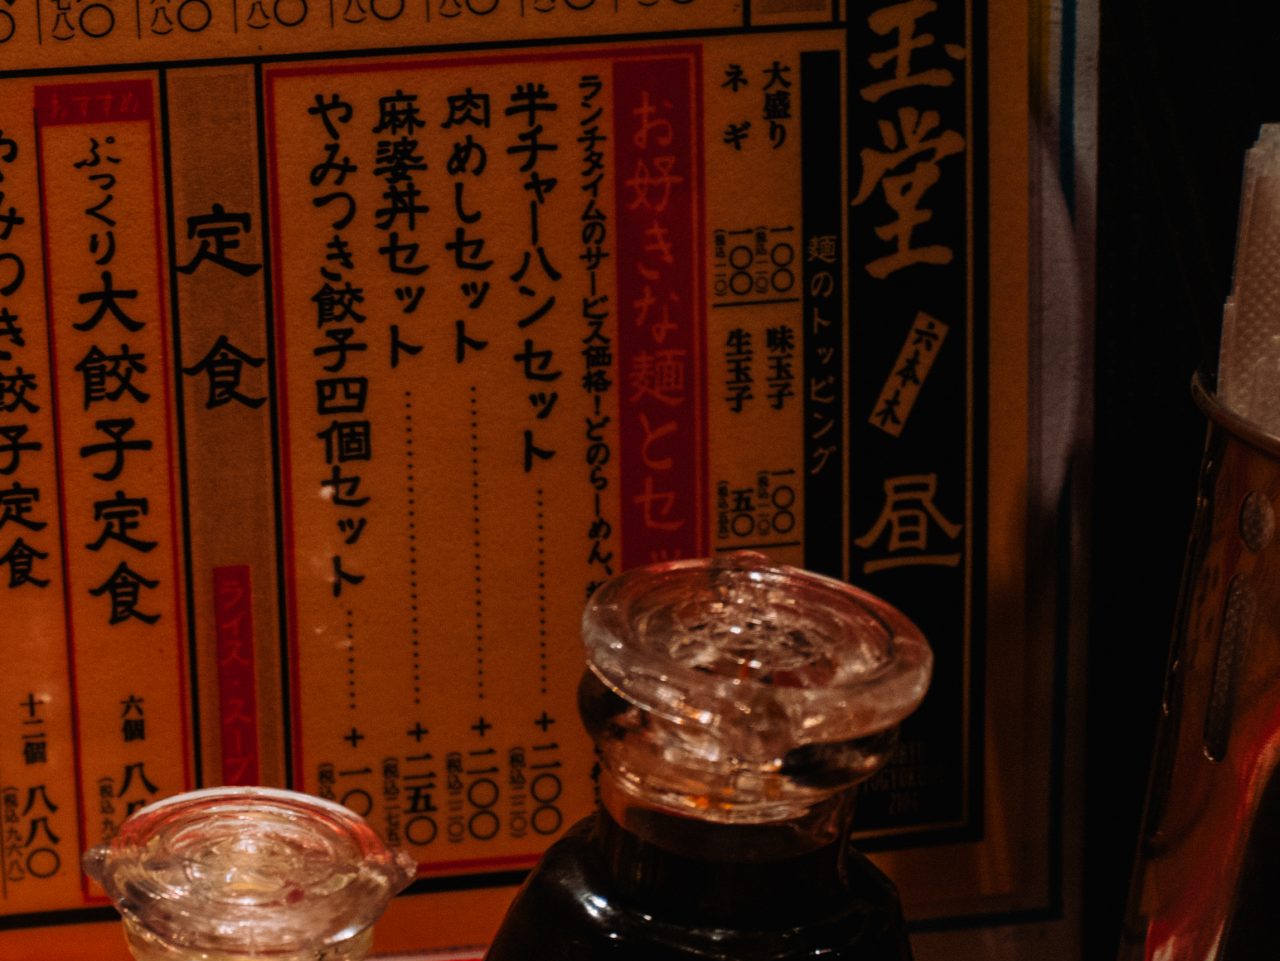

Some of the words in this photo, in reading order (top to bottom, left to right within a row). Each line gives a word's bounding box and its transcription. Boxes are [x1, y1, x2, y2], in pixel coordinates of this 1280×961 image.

[762, 61, 791, 149] 大盛り
[174, 203, 268, 411] 定食
[372, 90, 430, 368] 麻婆丼セット
[440, 88, 494, 363] 肉めしセット
[308, 93, 372, 598] やみつき餃子四個セット
[854, 473, 962, 574] 昼
[22, 785, 61, 879] 八八〇
